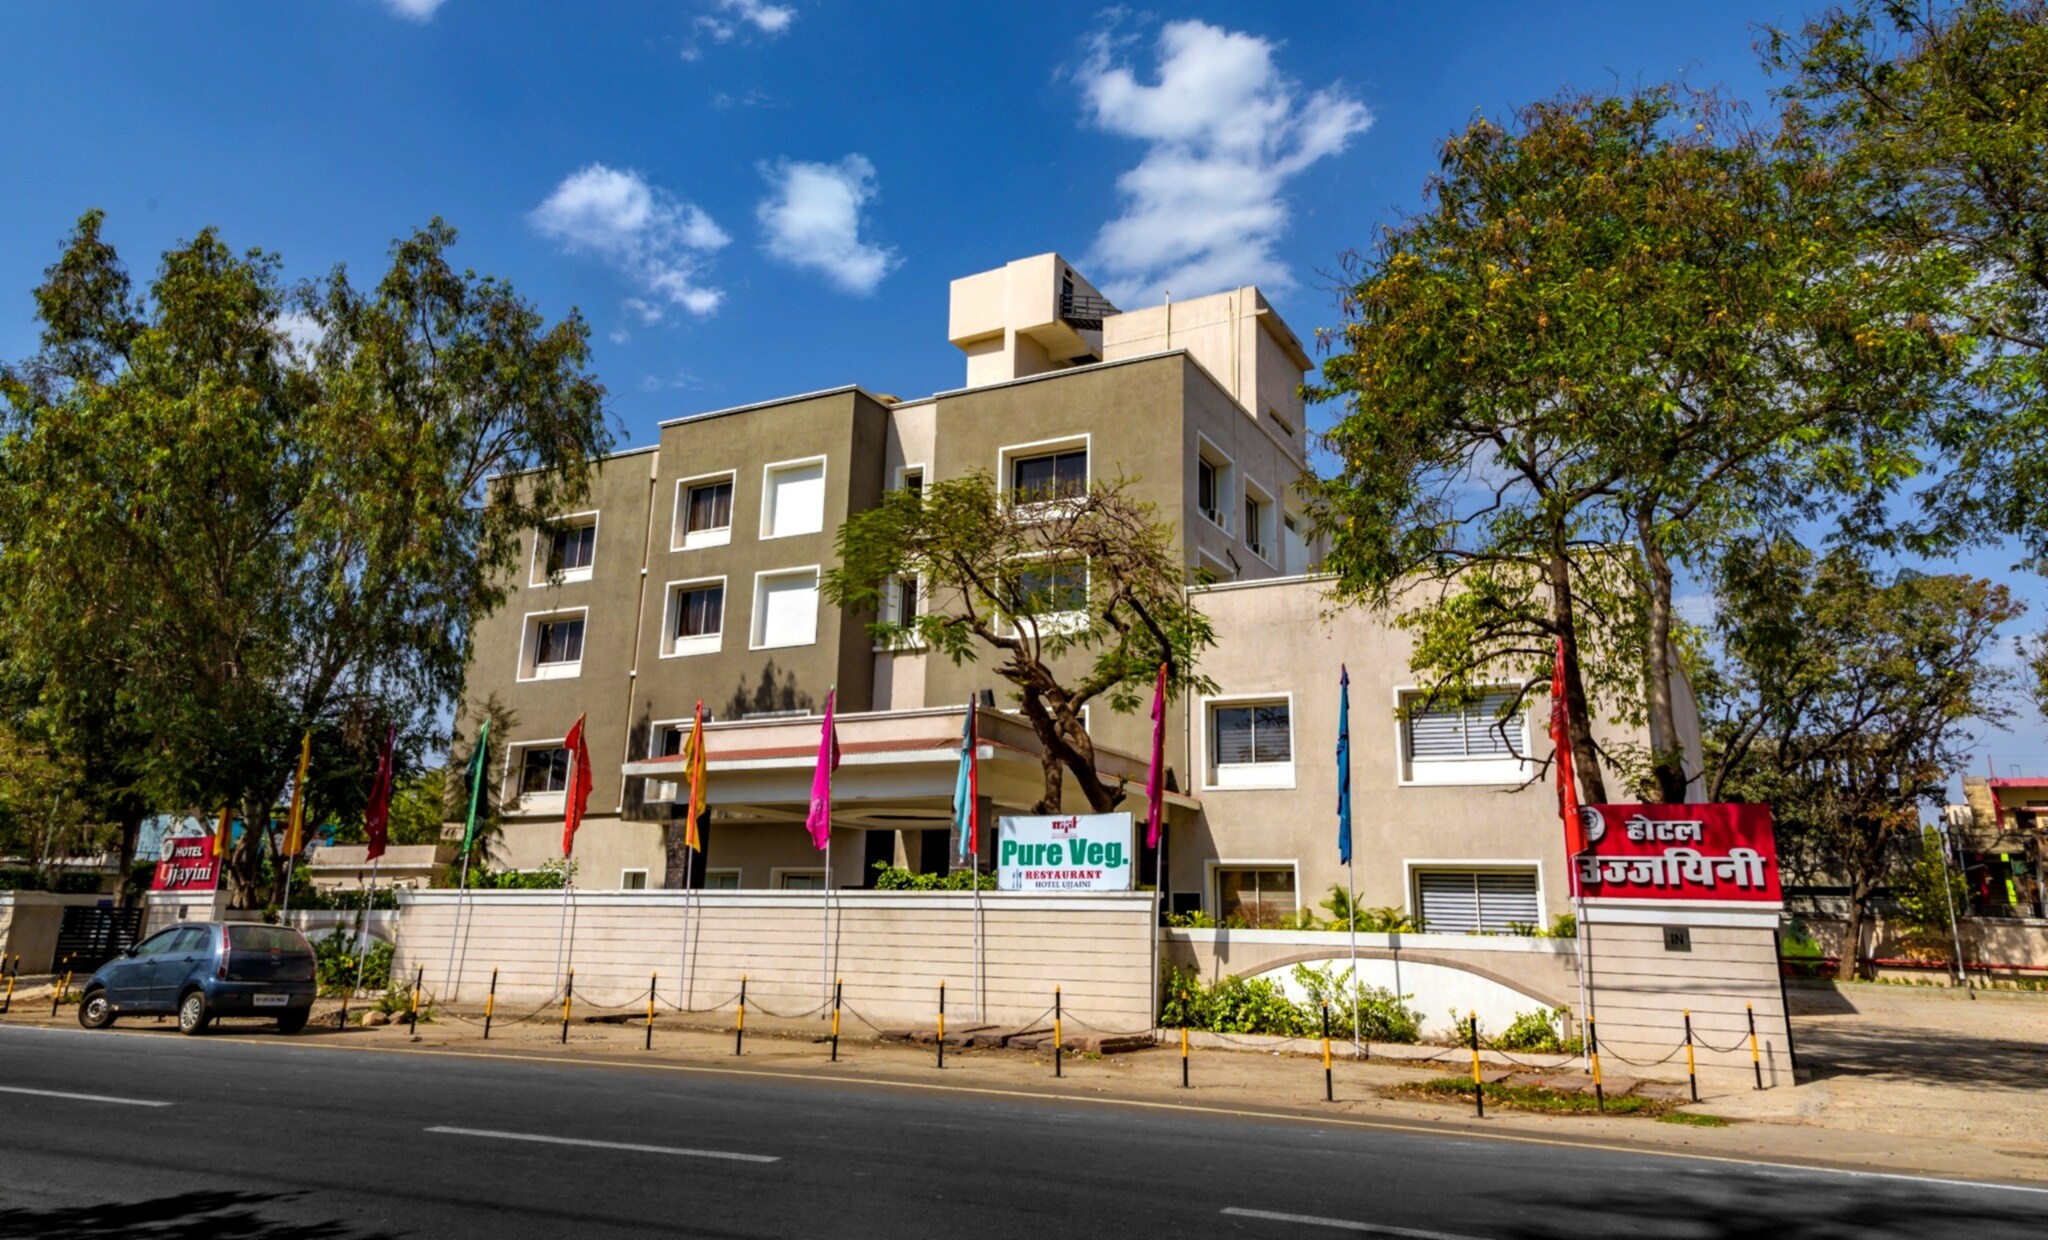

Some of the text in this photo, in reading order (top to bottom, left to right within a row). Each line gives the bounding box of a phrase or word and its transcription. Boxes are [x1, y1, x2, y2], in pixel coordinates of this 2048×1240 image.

[1624, 814, 1703, 841] होटल
[175, 846, 203, 857] HOTEL
[1001, 839, 1128, 868] Pure Veg.
[160, 862, 213, 887] Ujjayini
[1025, 870, 1102, 880] RESTAURANT
[1575, 847, 1767, 887] उज्जयिनी
[1035, 881, 1091, 889] HOTEL UJJAINI
[1671, 933, 1684, 945] IN
